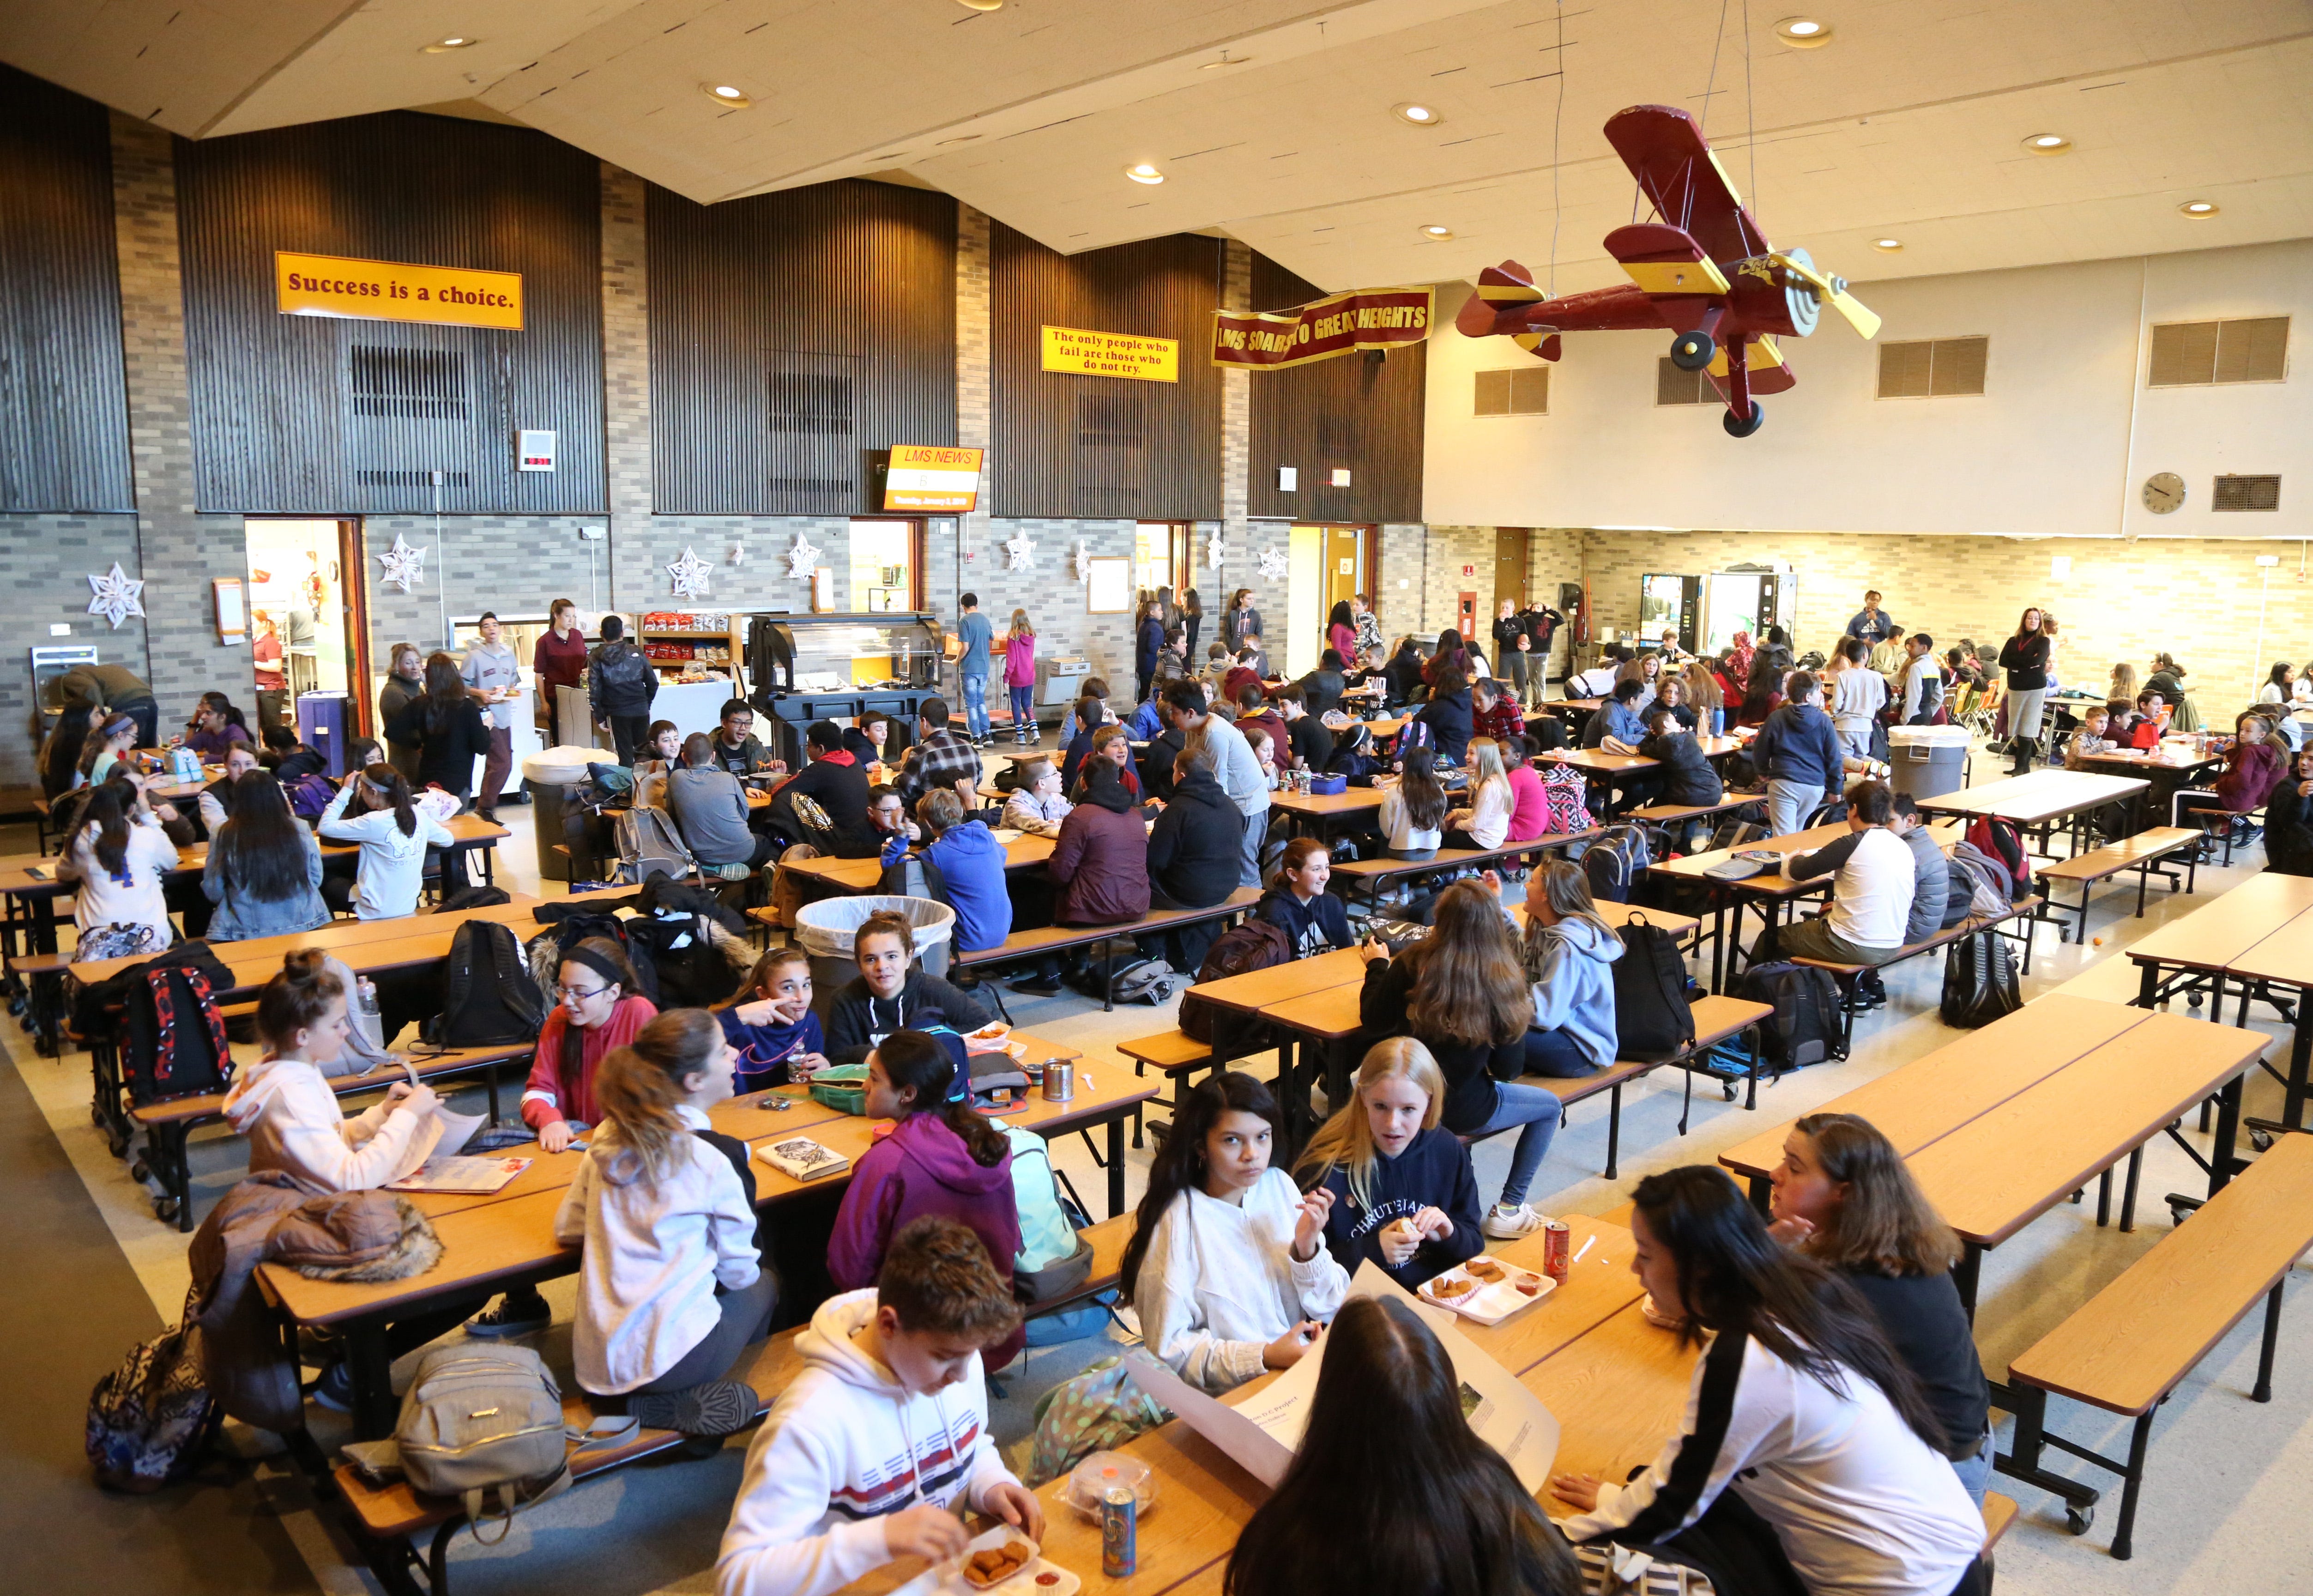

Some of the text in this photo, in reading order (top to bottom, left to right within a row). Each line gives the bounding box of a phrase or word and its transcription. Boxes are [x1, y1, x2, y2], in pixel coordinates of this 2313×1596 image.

[289, 273, 514, 308] Success is a choice.
[1218, 327, 1246, 350] LMS
[1248, 329, 1294, 353] SOARS
[1292, 323, 1310, 345] TO
[1358, 306, 1426, 328] HEIGHTS
[1053, 331, 1168, 352] The only people who
[1060, 346, 1161, 364] fail are those who
[1084, 359, 1141, 375] do not try.
[905, 449, 972, 464] LMS NEWS
[1293, 945, 1337, 960] addas
[1274, 1396, 1298, 1412] Project
